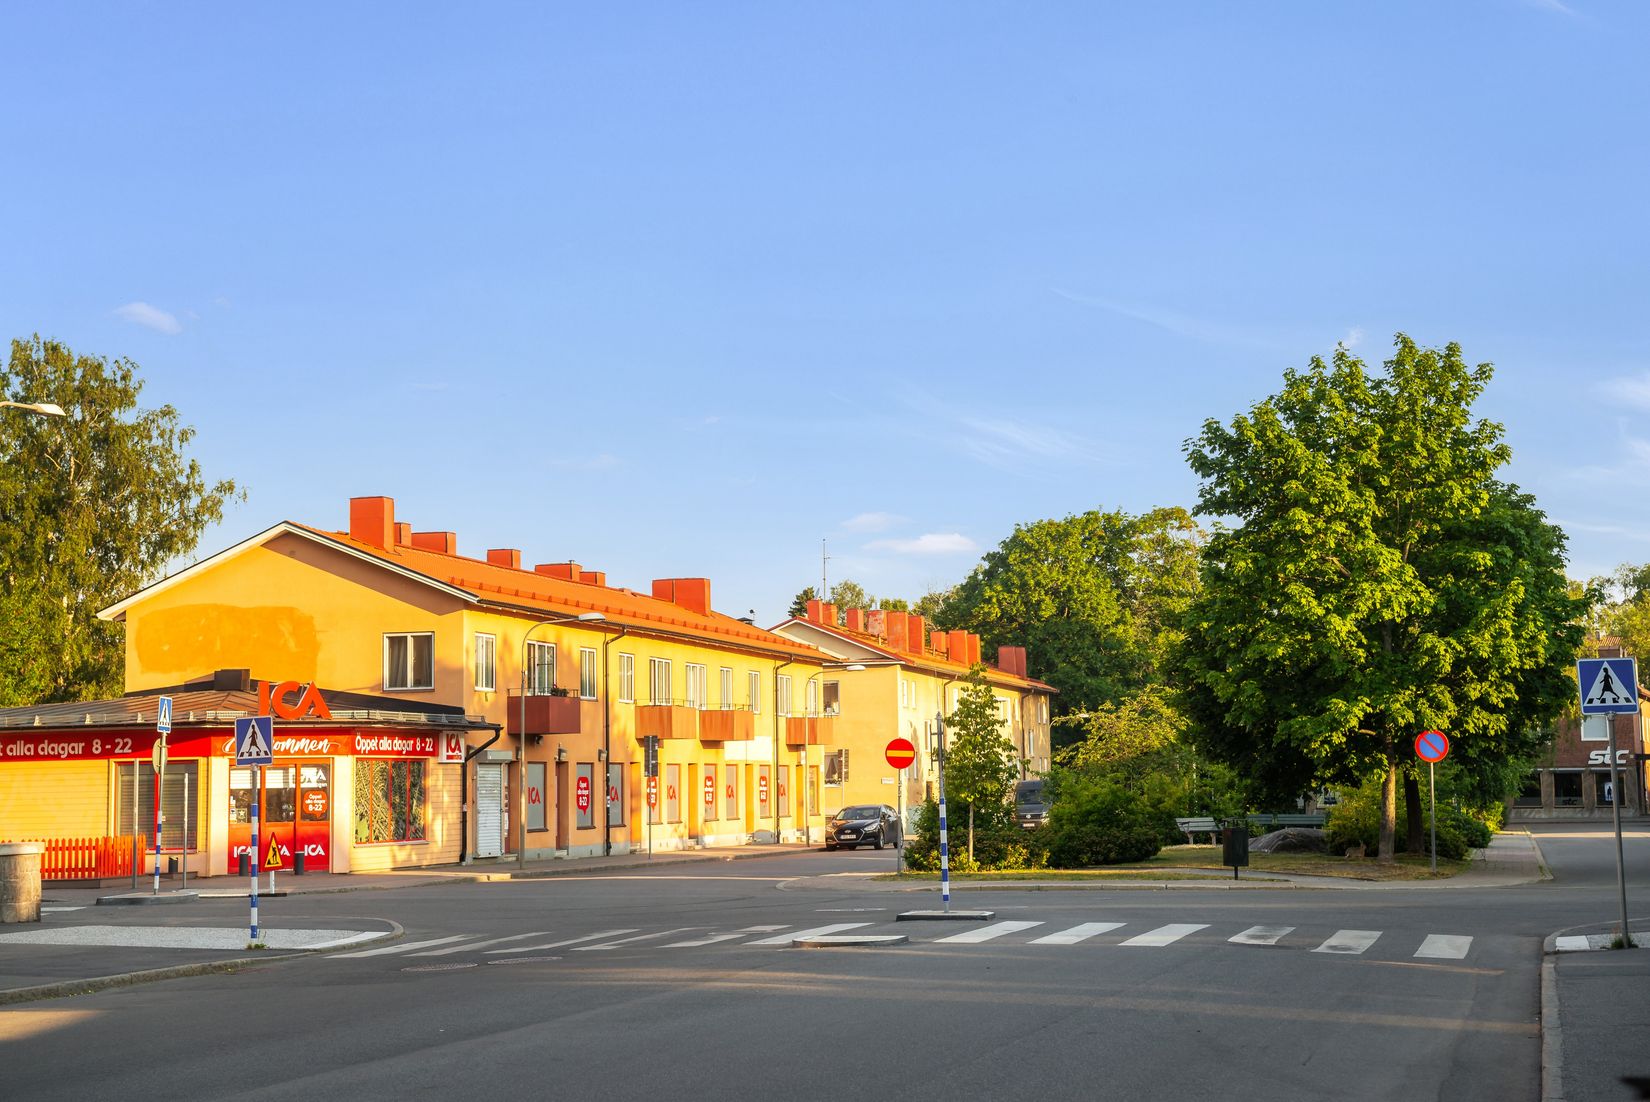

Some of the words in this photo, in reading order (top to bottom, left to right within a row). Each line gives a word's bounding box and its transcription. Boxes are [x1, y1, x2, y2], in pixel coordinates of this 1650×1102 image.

[257, 681, 333, 720] ICA
[6, 741, 34, 756] alla
[38, 740, 85, 758] dagar
[92, 739, 102, 754] 8
[114, 738, 132, 753] 22
[355, 733, 379, 754] Öppet
[379, 737, 392, 751] alla
[393, 737, 414, 754] dagar
[416, 737, 421, 751] 8
[425, 738, 433, 751] 22
[446, 733, 462, 753] ICA
[1588, 746, 1629, 764] stc
[527, 786, 541, 805] ICA
[304, 844, 325, 856] ICA
